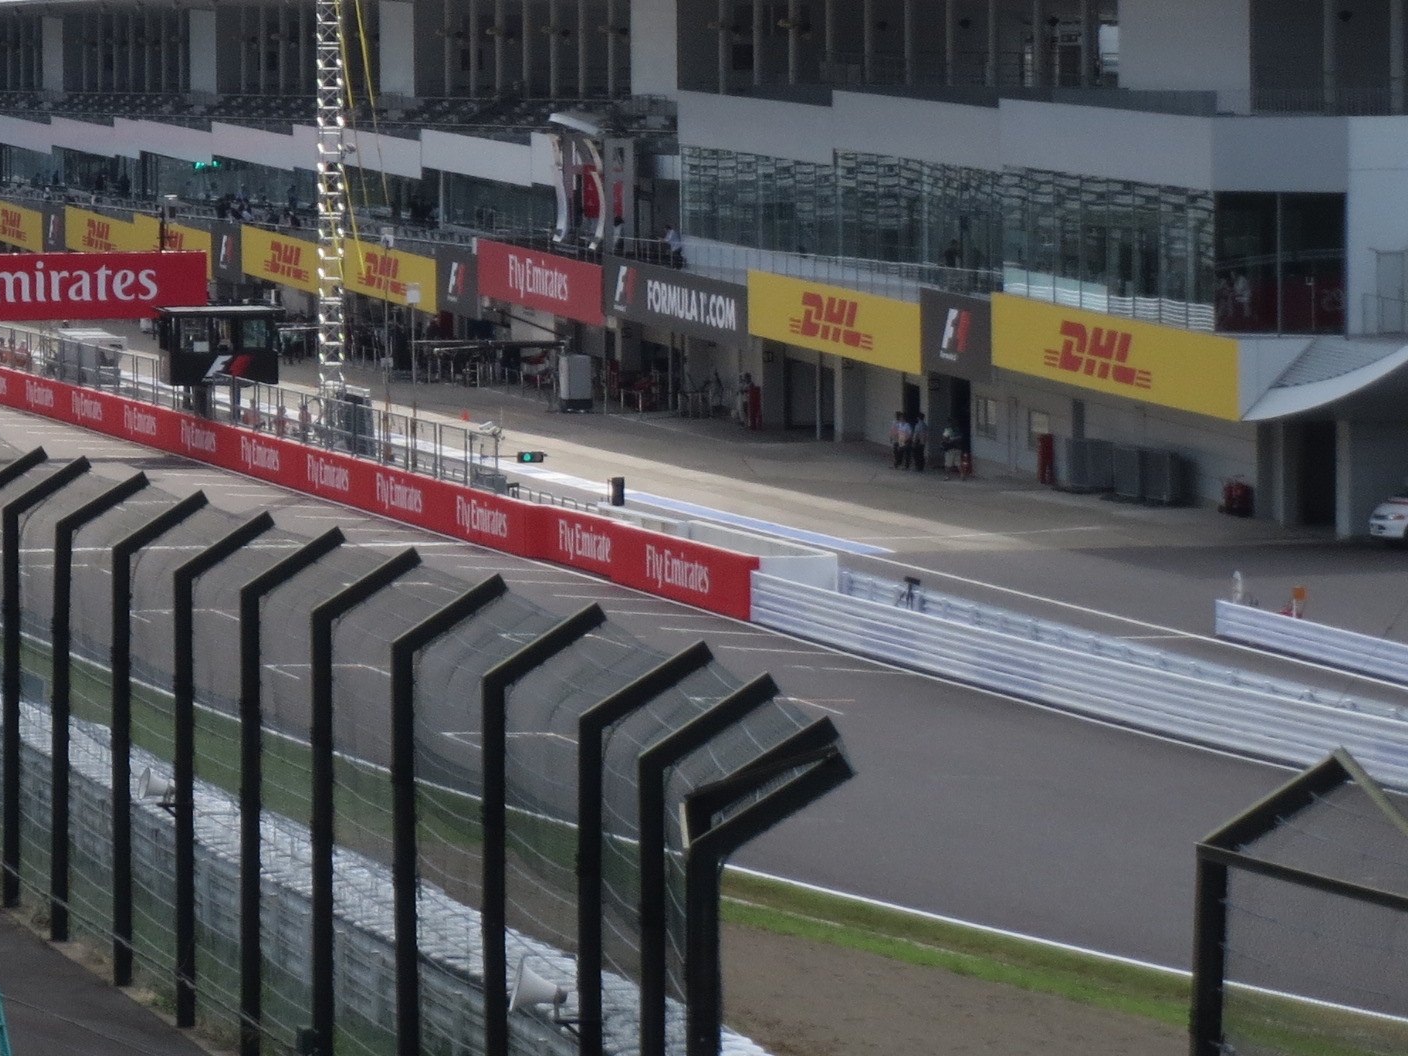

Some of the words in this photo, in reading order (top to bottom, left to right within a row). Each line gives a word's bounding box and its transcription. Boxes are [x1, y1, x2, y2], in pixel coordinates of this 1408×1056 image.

[508, 253, 525, 299] Fly
[526, 255, 569, 301] Emirates
[798, 290, 866, 350] DHL
[1054, 319, 1143, 387] DHL
[241, 435, 252, 470] Fly
[252, 439, 280, 472] Emirates
[307, 454, 319, 489] Fly
[319, 458, 349, 492] Emirates
[376, 472, 390, 510] Fly
[390, 475, 423, 513] Emirates
[456, 495, 470, 533] Fly
[471, 499, 508, 538] Emirates
[558, 519, 574, 560] Fly
[645, 544, 663, 589] Fly
[664, 549, 710, 594] Emirates
